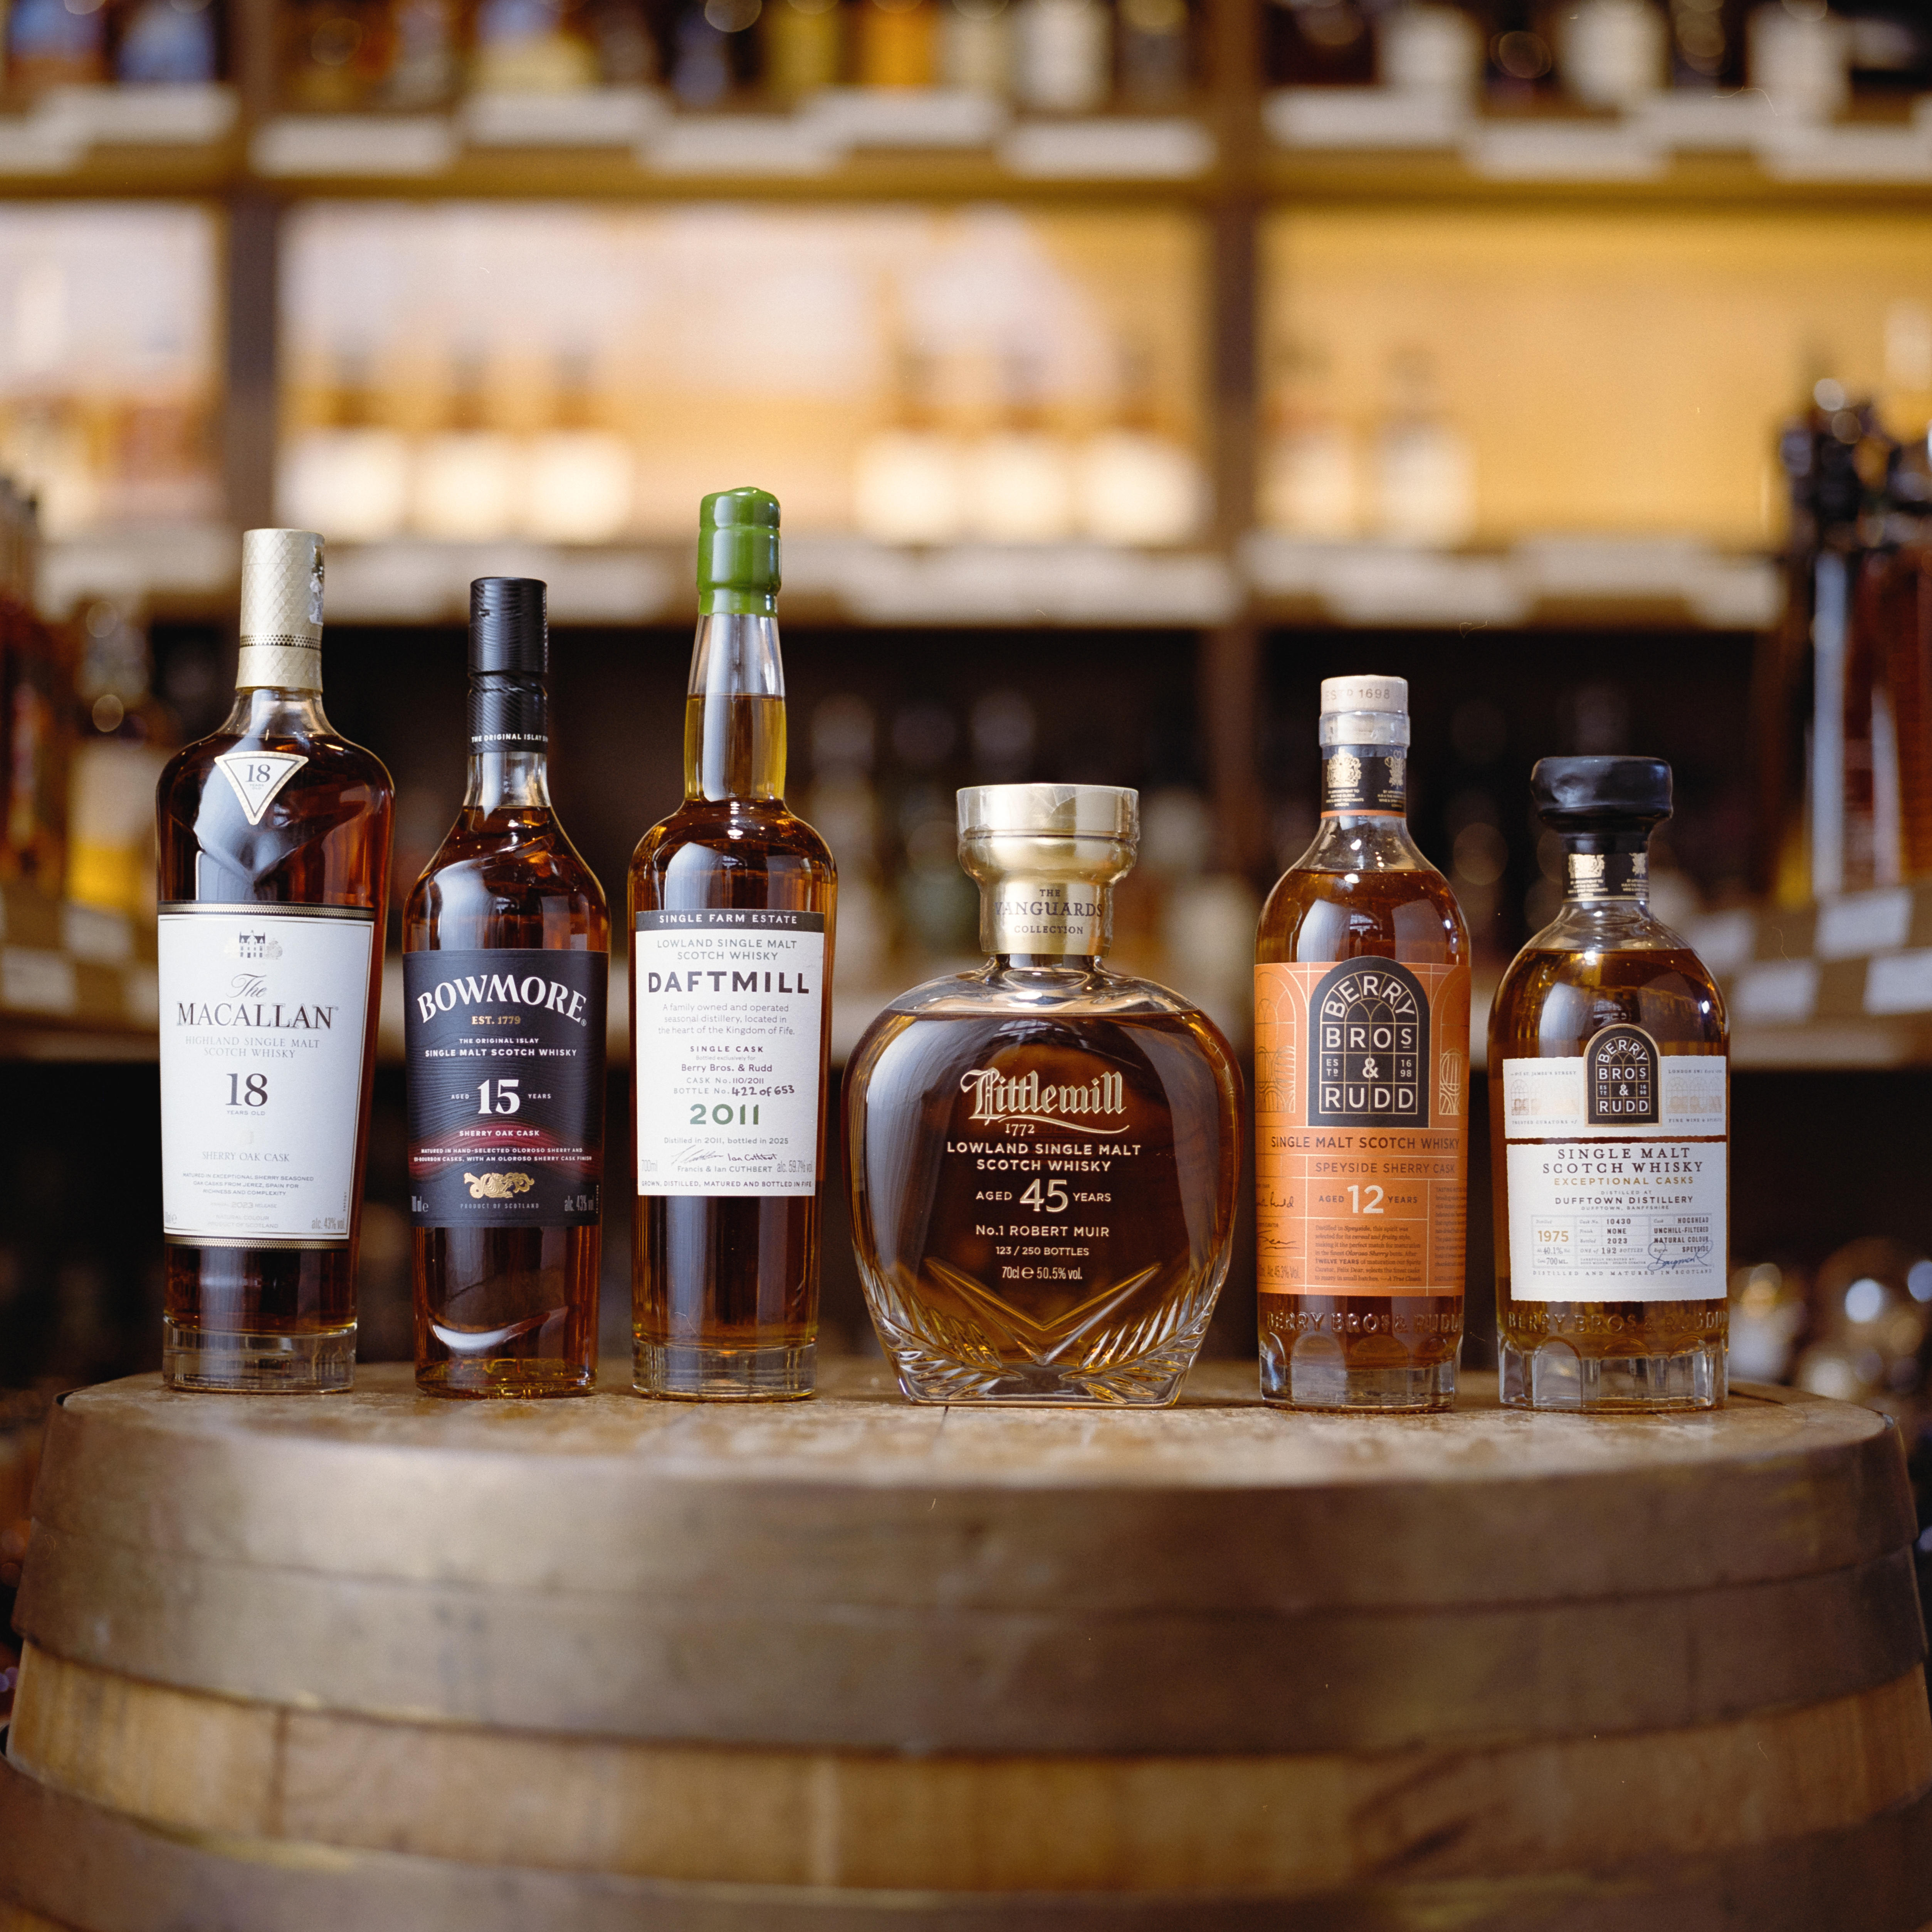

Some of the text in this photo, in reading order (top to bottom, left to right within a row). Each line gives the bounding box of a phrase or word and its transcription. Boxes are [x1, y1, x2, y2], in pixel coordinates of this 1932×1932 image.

[1359, 688, 1390, 699] 1698
[245, 764, 270, 782] 18
[995, 902, 1102, 917] VANGUARDS
[659, 914, 797, 923] SINGLE FARM ESTATE
[1015, 926, 1083, 934] COLLECTION
[657, 940, 712, 948] LOWLAND
[768, 940, 797, 949] MALT
[729, 952, 778, 960] WHISKY
[227, 974, 267, 998] The
[649, 971, 809, 994] DAFTMILL
[417, 975, 586, 1023] BOWMORE
[1325, 975, 1415, 1018] BERRY
[670, 1004, 694, 1012] family
[750, 1004, 788, 1013] operated
[177, 1002, 333, 1029] MACALLAN
[472, 1016, 521, 1025] EST. 1779
[701, 1015, 742, 1024] distillery,
[726, 1026, 766, 1035] Kingdom
[779, 1027, 795, 1035] Fife.
[185, 1036, 320, 1048] HIGHLAND SINGLE MALT
[1326, 1028, 1412, 1048] BROS
[204, 1049, 296, 1058] SCOTCH WHISKY
[425, 1049, 455, 1057] SINGLE
[1599, 1040, 1647, 1063] BERRY
[682, 1064, 706, 1073] Berry
[1362, 1058, 1379, 1078] &
[1599, 1068, 1646, 1079] BROS
[226, 1073, 268, 1107] 18
[1619, 1084, 1628, 1096] &
[477, 1079, 520, 1114] 15
[960, 1067, 1127, 1126] Littlemill
[1325, 1088, 1413, 1108] RUDD
[1599, 1100, 1648, 1112] RUDD
[690, 1104, 759, 1125] 2011
[1005, 1123, 1035, 1136] 1772
[947, 1141, 1141, 1155] LOWLAND SINGLE MALT
[1272, 1136, 1460, 1150] SINGLE MALT SCOTCH WHISKY
[202, 1151, 235, 1160] SHERRY
[265, 1153, 289, 1162] CASK
[1558, 1148, 1690, 1159] SINGLE MALT
[976, 1159, 1111, 1172] SCOTCH WHISKY
[1315, 1163, 1455, 1173] SPEYSIDE SHERRY CASK
[1543, 1162, 1703, 1173] SCOTCH WHISKY
[1554, 1176, 1693, 1185] EXCEPTIONAL CASKS
[976, 1178, 1111, 1212] AGED 45 YEARS
[1347, 1185, 1384, 1213] 12
[976, 1225, 1109, 1237] No.1 ROBERT MUIR
[1537, 1230, 1569, 1242] 1975
[996, 1247, 1011, 1255] 123
[1022, 1247, 1040, 1255] 250
[1044, 1247, 1089, 1256] BOTTLES
